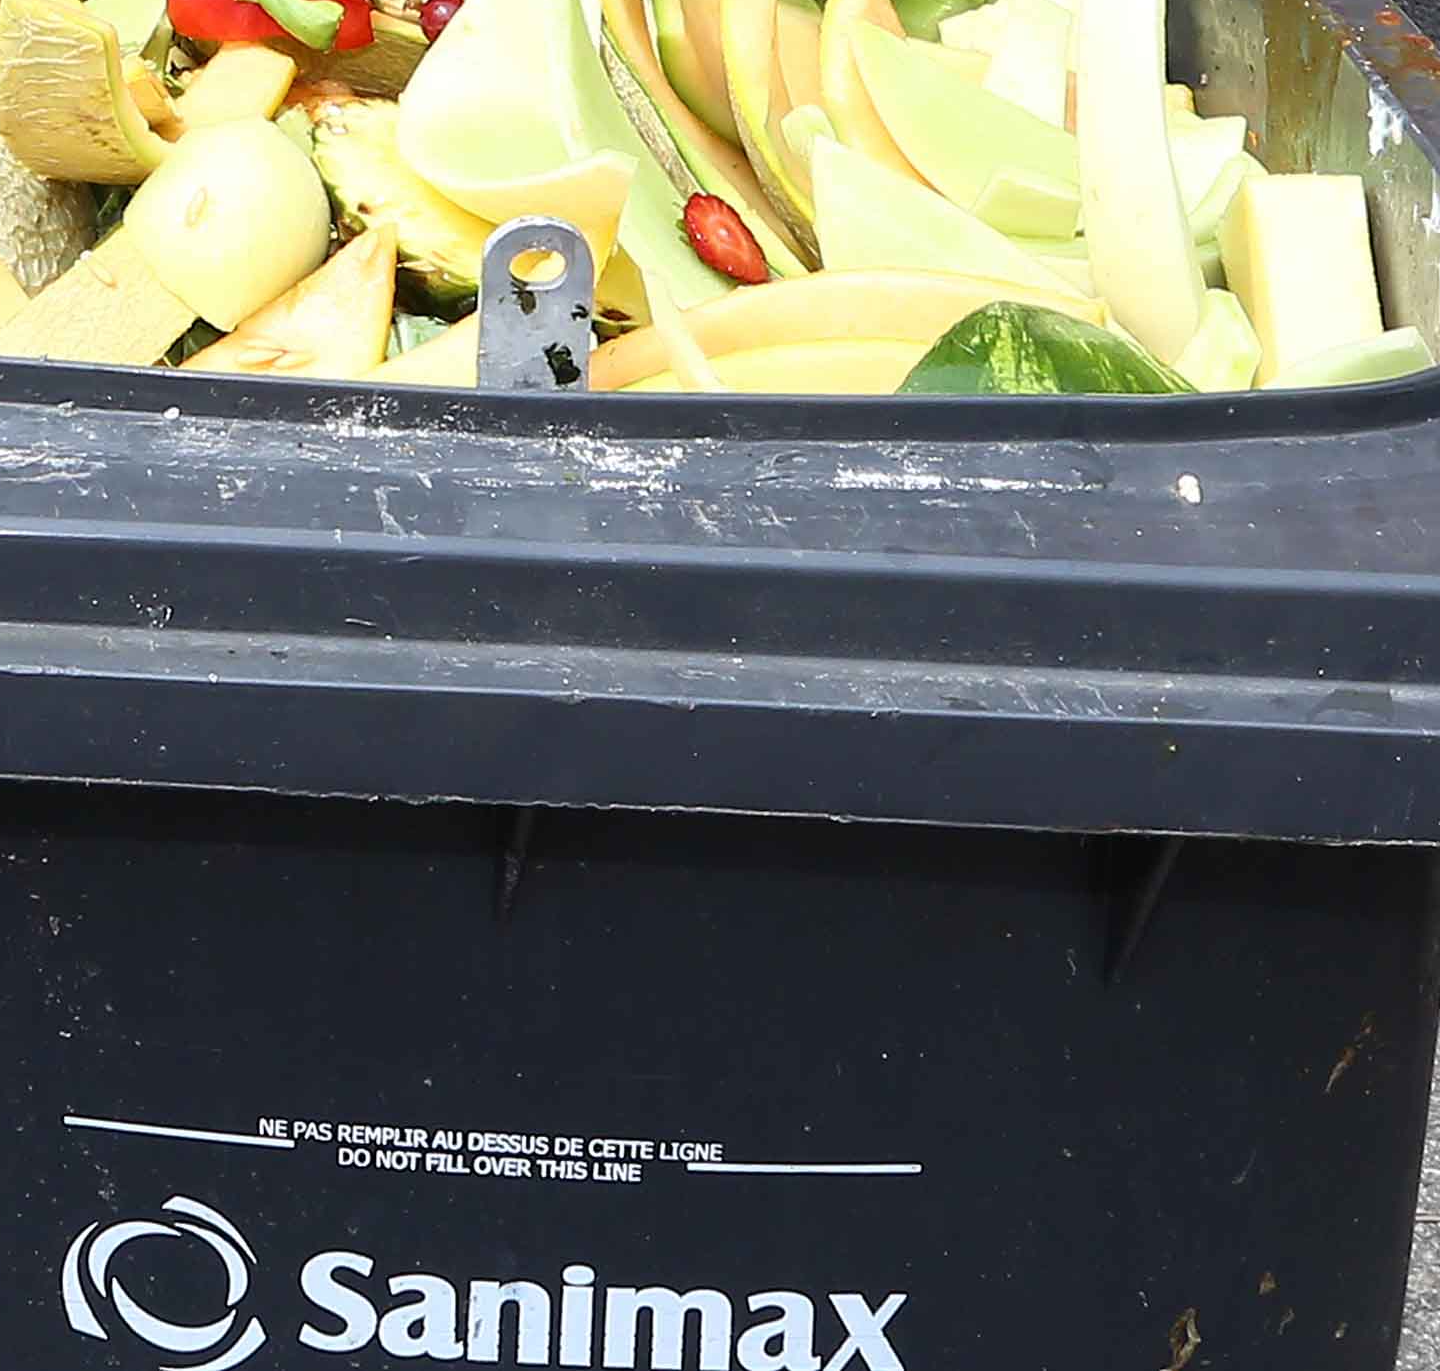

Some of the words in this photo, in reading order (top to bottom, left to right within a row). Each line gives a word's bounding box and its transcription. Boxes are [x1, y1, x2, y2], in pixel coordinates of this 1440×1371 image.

[258, 1117, 289, 1138] NE
[293, 1121, 333, 1142] PAS
[337, 1124, 429, 1149] REMPLIR
[431, 1130, 463, 1151] AU
[467, 1132, 550, 1155] DESSUS
[553, 1136, 585, 1157] DE
[588, 1138, 655, 1160] CETTE
[659, 1142, 724, 1162] LIGNE
[338, 1147, 371, 1167] DO
[375, 1149, 423, 1171] NOT
[425, 1152, 471, 1174] FILL
[473, 1155, 532, 1178] OVER
[535, 1159, 588, 1180] THIS
[592, 1162, 642, 1182] LINE
[298, 1250, 909, 1371] Sanimax
